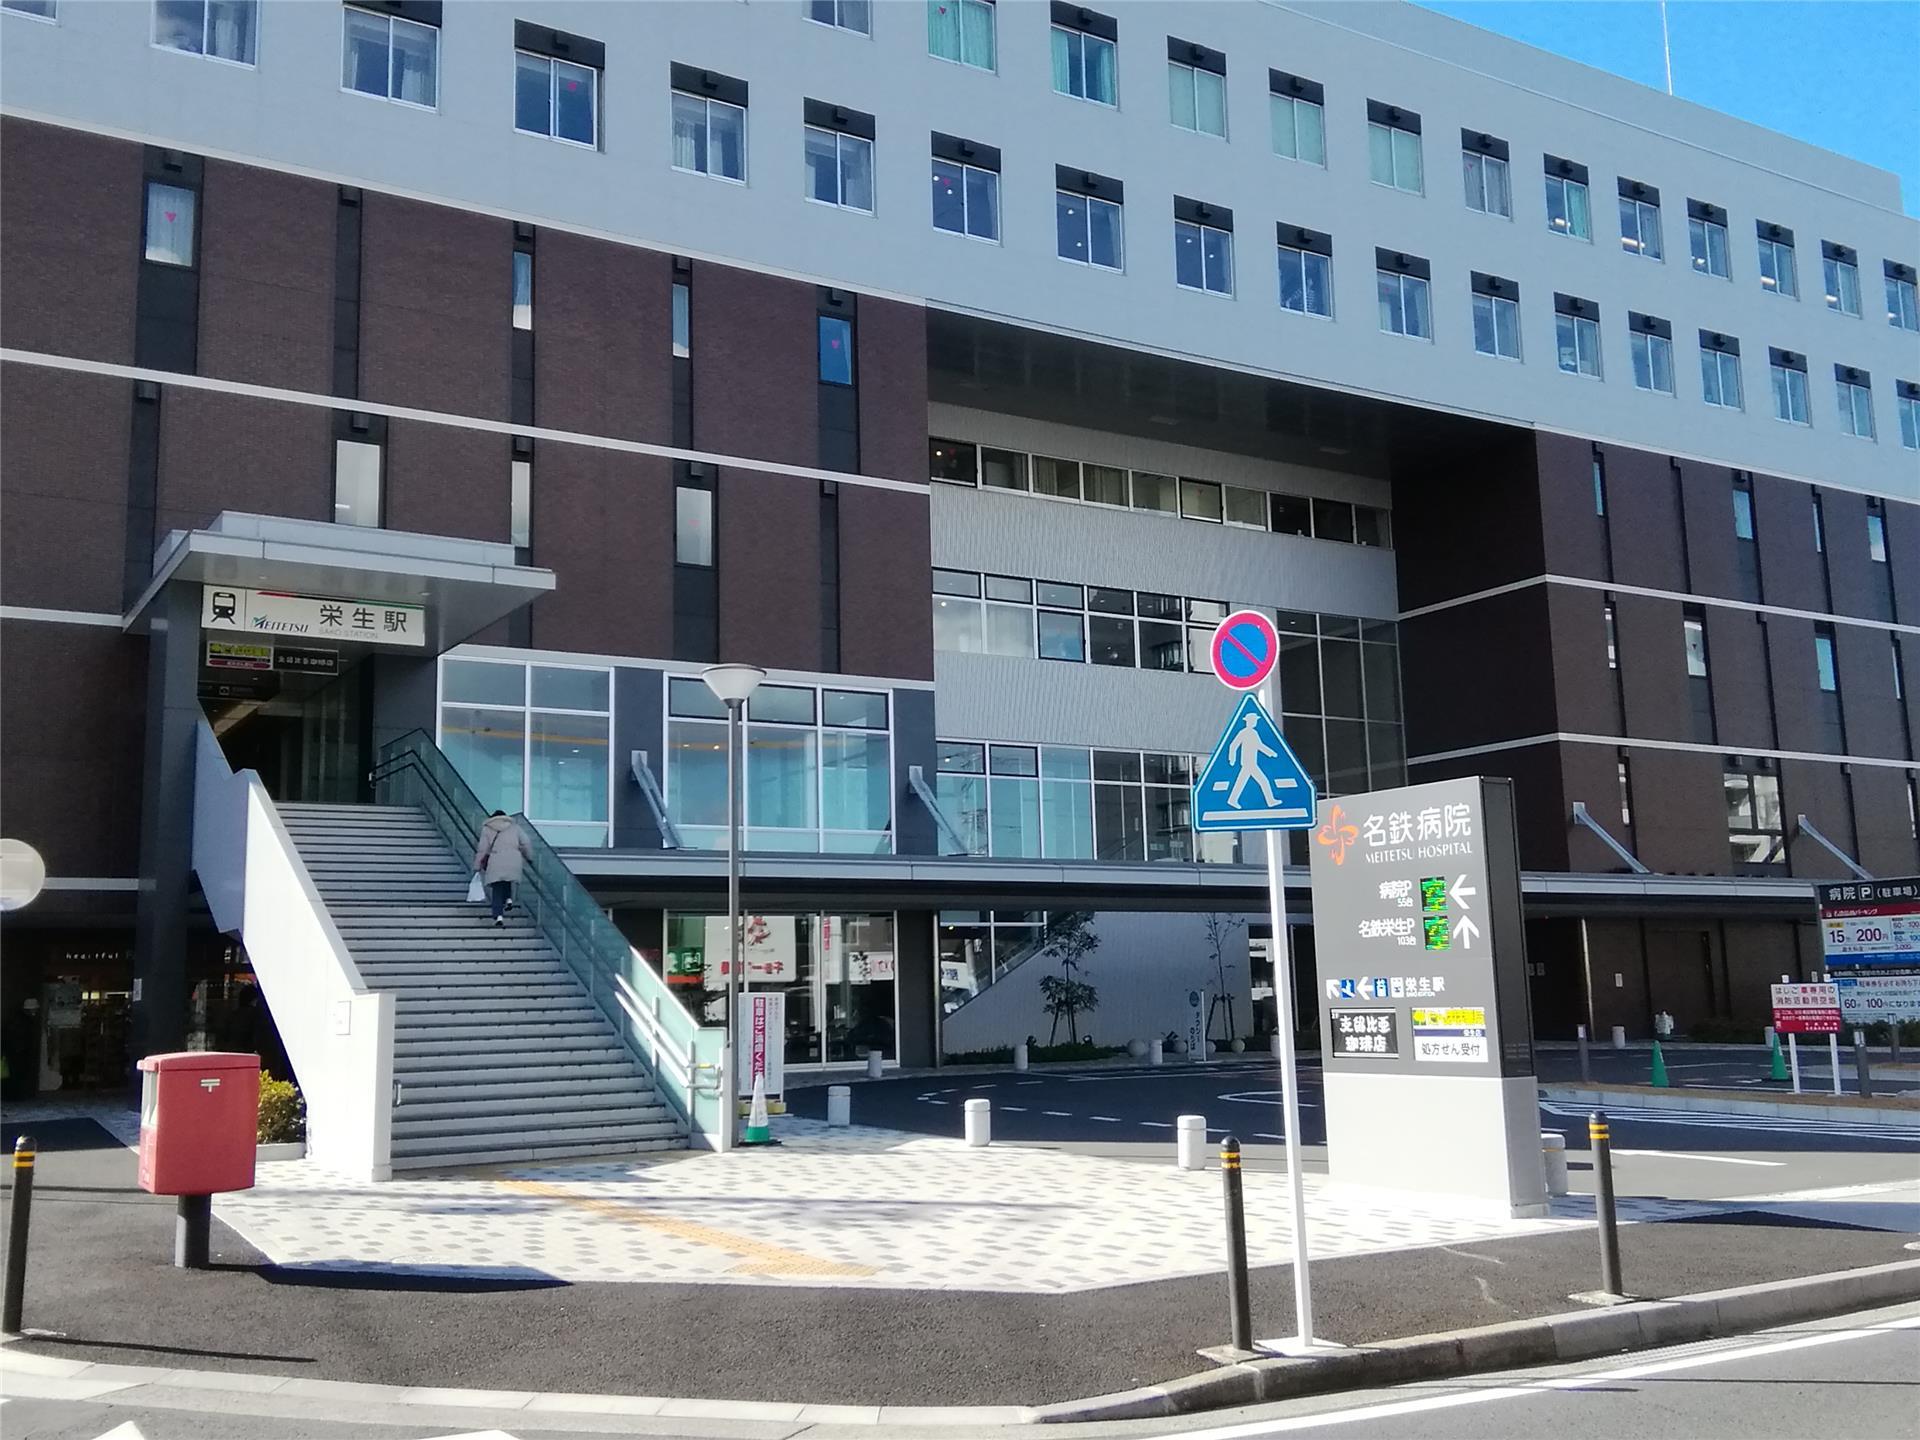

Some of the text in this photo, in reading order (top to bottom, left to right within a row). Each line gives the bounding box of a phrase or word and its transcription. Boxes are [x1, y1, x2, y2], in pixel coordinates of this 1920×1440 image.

[252, 614, 311, 634] MEITETSU
[319, 603, 407, 634] 栄生駅
[344, 629, 379, 640] STATION
[1362, 802, 1472, 848] 名鉄病院
[1365, 841, 1473, 865] MEITETSU HOSPITAL
[1828, 887, 1857, 901] 病院
[1405, 976, 1446, 992] 栄生駅
[1345, 1035, 1387, 1052] 珈琲店
[1421, 1042, 1481, 1057] 処方せん受付
